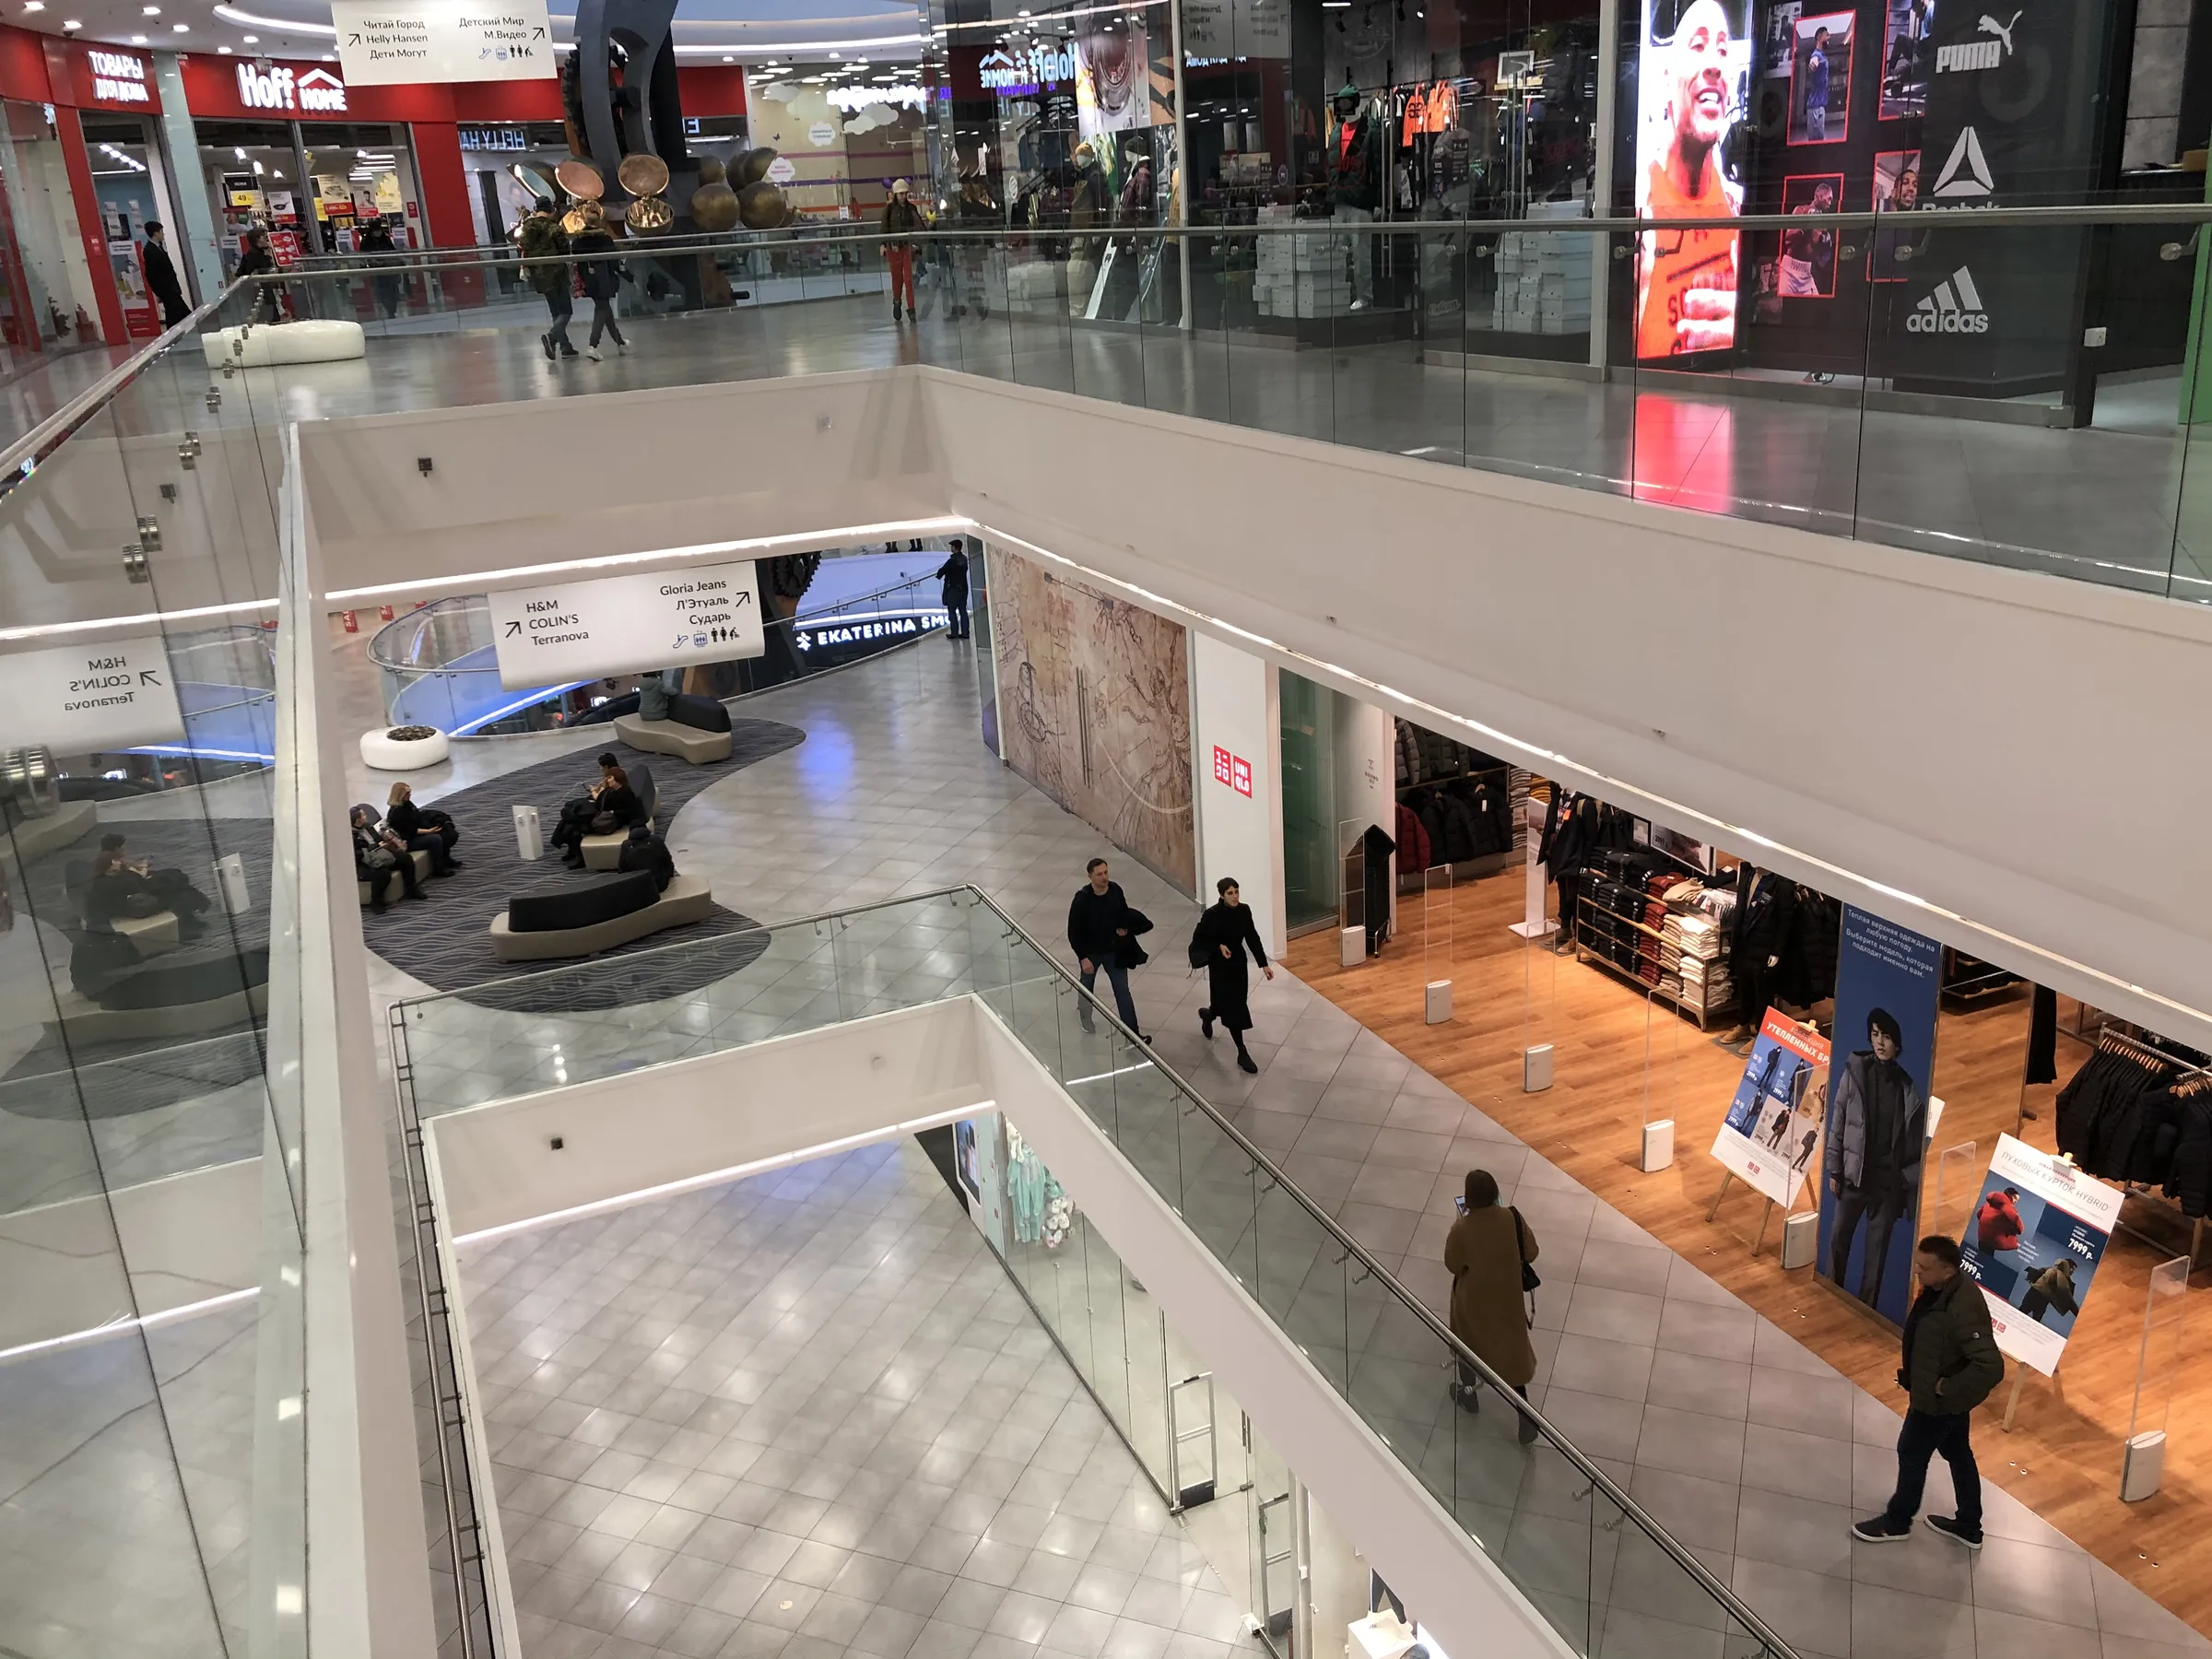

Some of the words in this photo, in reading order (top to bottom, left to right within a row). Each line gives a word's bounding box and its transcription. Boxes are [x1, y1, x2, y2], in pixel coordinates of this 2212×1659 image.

[363, 20, 394, 29] Читай
[396, 19, 426, 30] Город
[459, 17, 500, 29] Детский
[502, 17, 524, 27] Мир
[366, 34, 391, 44] Helly
[393, 34, 429, 43] Hansen
[484, 29, 527, 41] М.Видео
[370, 49, 394, 60] Дети
[396, 49, 427, 59] Могут
[1936, 40, 2001, 74] PUMA
[88, 50, 145, 79] ТОВАРЫ
[298, 88, 347, 111] HOME
[1906, 308, 1989, 333] adidas
[660, 582, 694, 595] Gloria
[696, 580, 727, 592] Jeans
[526, 599, 559, 613] H&M
[676, 596, 729, 610] Л'Этуаль
[528, 614, 580, 629] COLIN'S
[689, 612, 731, 626] Сударь
[531, 630, 590, 645] Terranova
[817, 618, 916, 646] EKATERINA
[1847, 909, 1870, 924] Теплая
[1871, 920, 1898, 936] верхняя
[1899, 932, 1925, 948] одежда
[1926, 944, 1936, 953] на
[1865, 927, 1888, 942] любую
[1889, 937, 1913, 953] погоду.
[1845, 927, 1877, 947] Выберите
[1879, 945, 1905, 960] модель,
[1906, 956, 1934, 973] которая
[1852, 941, 1882, 959] подходит
[1883, 955, 1909, 971] именно
[1909, 965, 1924, 978] вам.
[1767, 1021, 1818, 1057] УТЕПЛЕННЫХ
[2001, 1150, 2040, 1177] ПУХОВЫХ
[2041, 1173, 2077, 1194] КУРТОК
[2076, 1190, 2110, 1212] HYBRID
[2067, 1238, 2088, 1255] 7999
[1959, 1259, 1978, 1276] 7999
